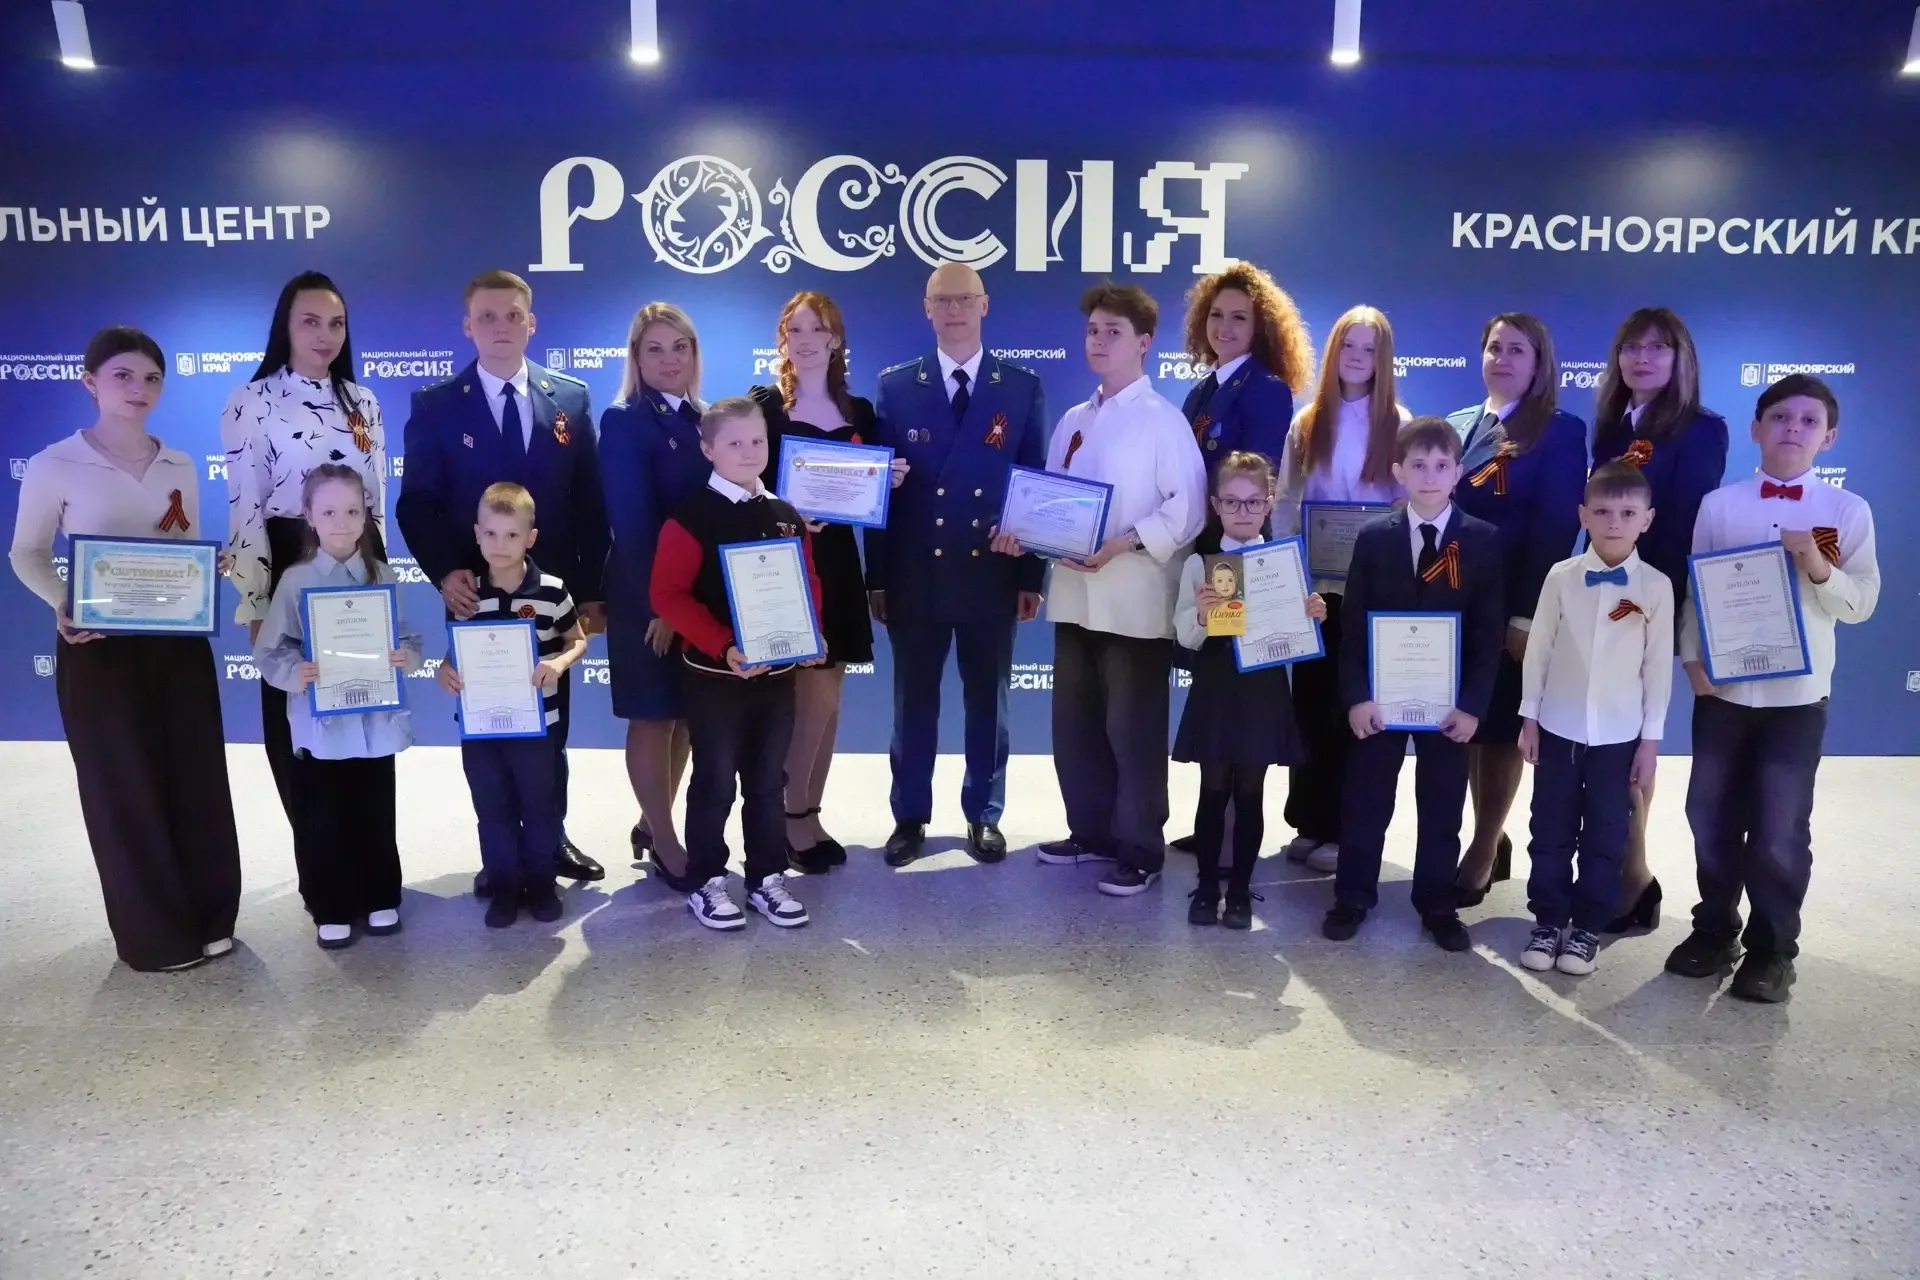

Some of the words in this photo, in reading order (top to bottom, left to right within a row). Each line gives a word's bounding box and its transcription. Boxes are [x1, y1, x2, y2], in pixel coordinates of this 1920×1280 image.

[528, 155, 1249, 274] РОССИЯ
[0, 197, 168, 242] ЛЬНЫЙ
[182, 205, 331, 247] ЦЕНТР
[1452, 207, 1857, 254] КРАСНОЯРСКИЙ
[361, 349, 427, 359] НАЦИОНАЛЬНЫЙ
[428, 350, 454, 359] ЦЕНТР
[202, 361, 231, 373] КРАЙ
[362, 360, 454, 378] РОССИЯ
[573, 357, 603, 369] КРАЙ
[1767, 363, 1856, 374] КРАСНОЯРСКИЙ
[1821, 467, 1847, 475] ЦЕНТР
